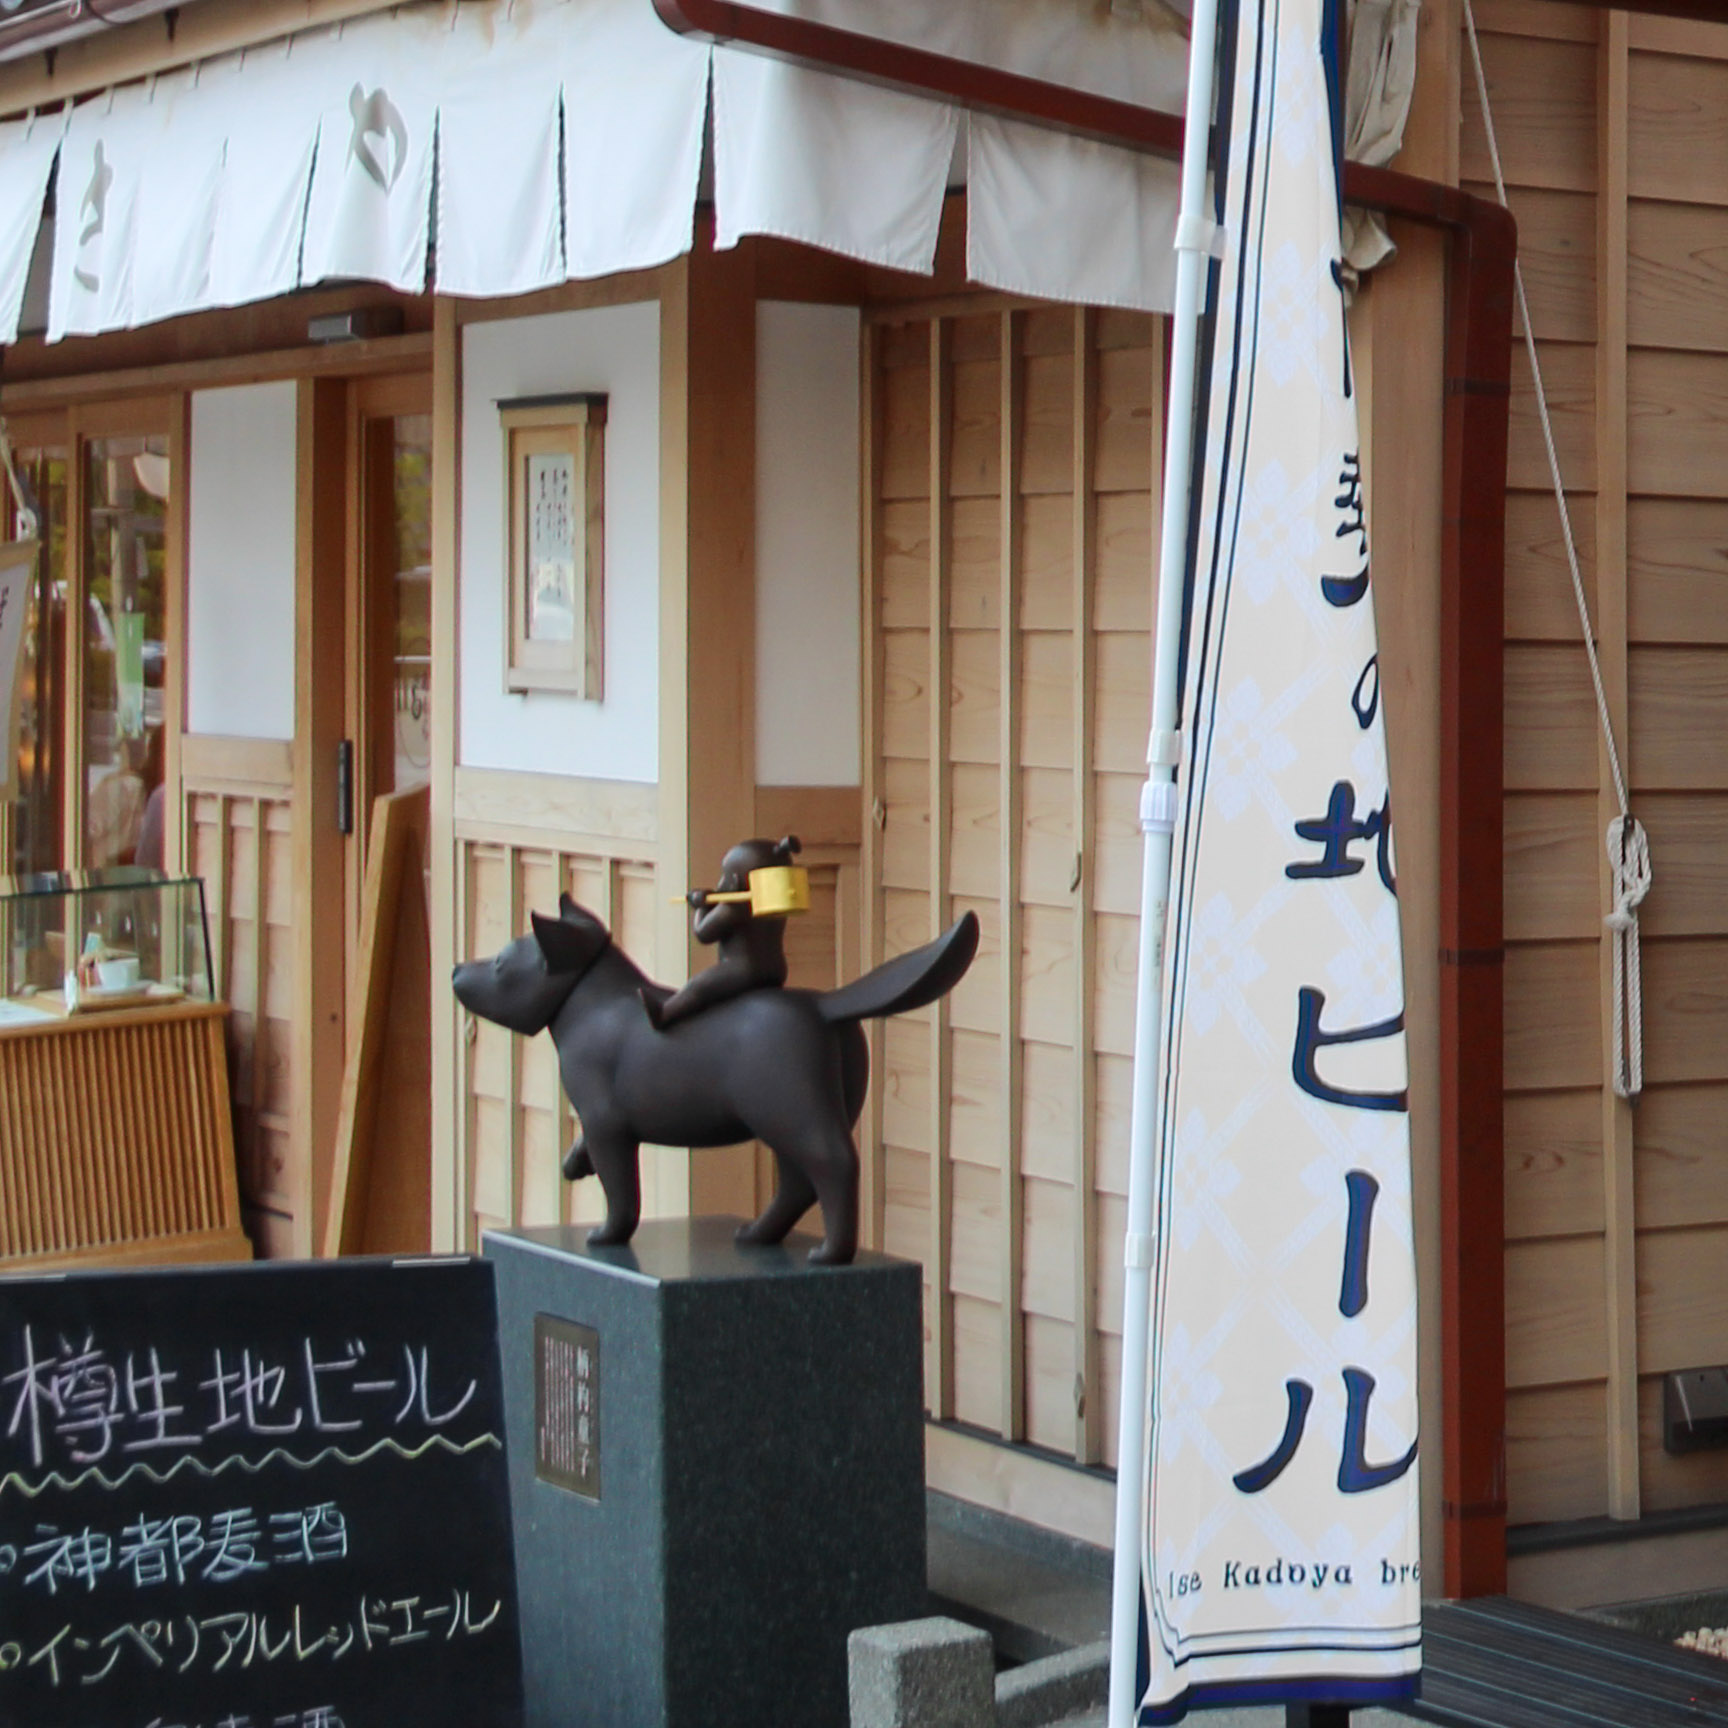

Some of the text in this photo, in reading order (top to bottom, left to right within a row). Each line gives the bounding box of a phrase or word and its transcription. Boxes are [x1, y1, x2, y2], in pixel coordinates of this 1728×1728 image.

[3, 1324, 476, 1466] 樽生地ビール
[22, 1500, 349, 1596] 神都麦酒
[1168, 1570, 1202, 1600] Ise
[1223, 1557, 1353, 1589] Kadoya
[27, 1587, 501, 1687] インペリアルレッドエール
